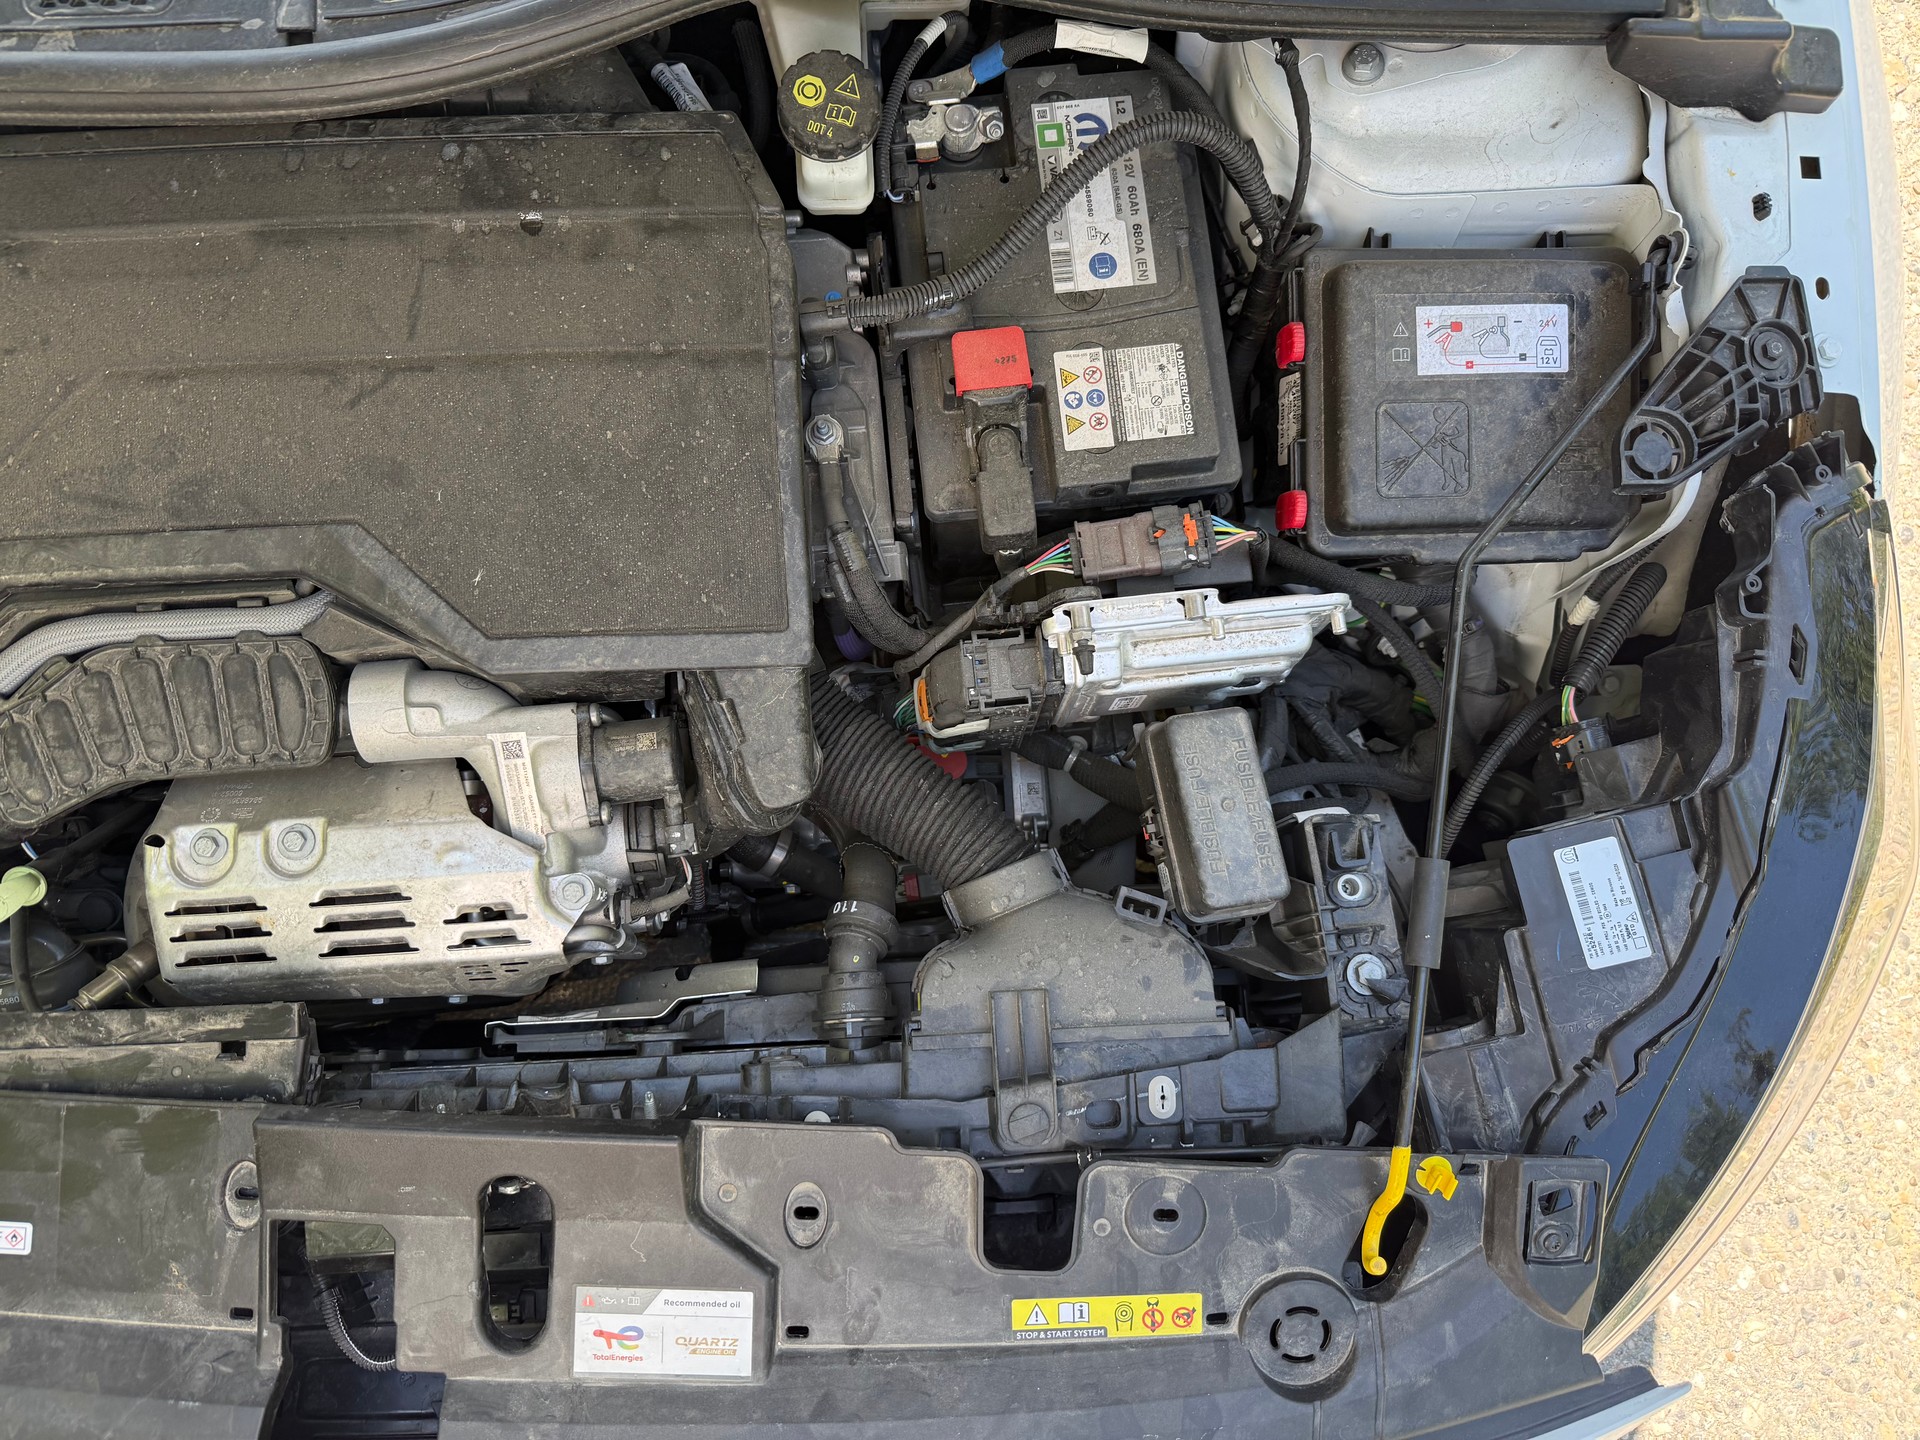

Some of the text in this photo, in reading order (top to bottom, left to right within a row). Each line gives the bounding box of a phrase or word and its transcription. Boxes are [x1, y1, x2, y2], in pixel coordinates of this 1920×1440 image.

[1115, 100, 1126, 115] L2
[807, 120, 833, 138] DOT 4
[1123, 157, 1135, 179] 12V
[1113, 185, 1123, 214] (SAE-GS)
[1126, 185, 1139, 216] 60Ah
[1054, 230, 1063, 241] Z1
[1132, 223, 1144, 254] 680A
[1134, 257, 1149, 282] (EN)
[1176, 351, 1194, 434] DANGER/POISON
[1181, 744, 1225, 874] FUSIBLE/FUSE
[1232, 737, 1275, 867] FUSIBLE/FUSE
[833, 900, 857, 914] 110
[664, 1300, 727, 1308] Recommended
[675, 1337, 739, 1346] QUARTZ
[1017, 1331, 1038, 1339] STOP
[1047, 1330, 1072, 1338] START
[1074, 1329, 1104, 1337] SYSTEM
[593, 1354, 643, 1362] TotalEnergies
